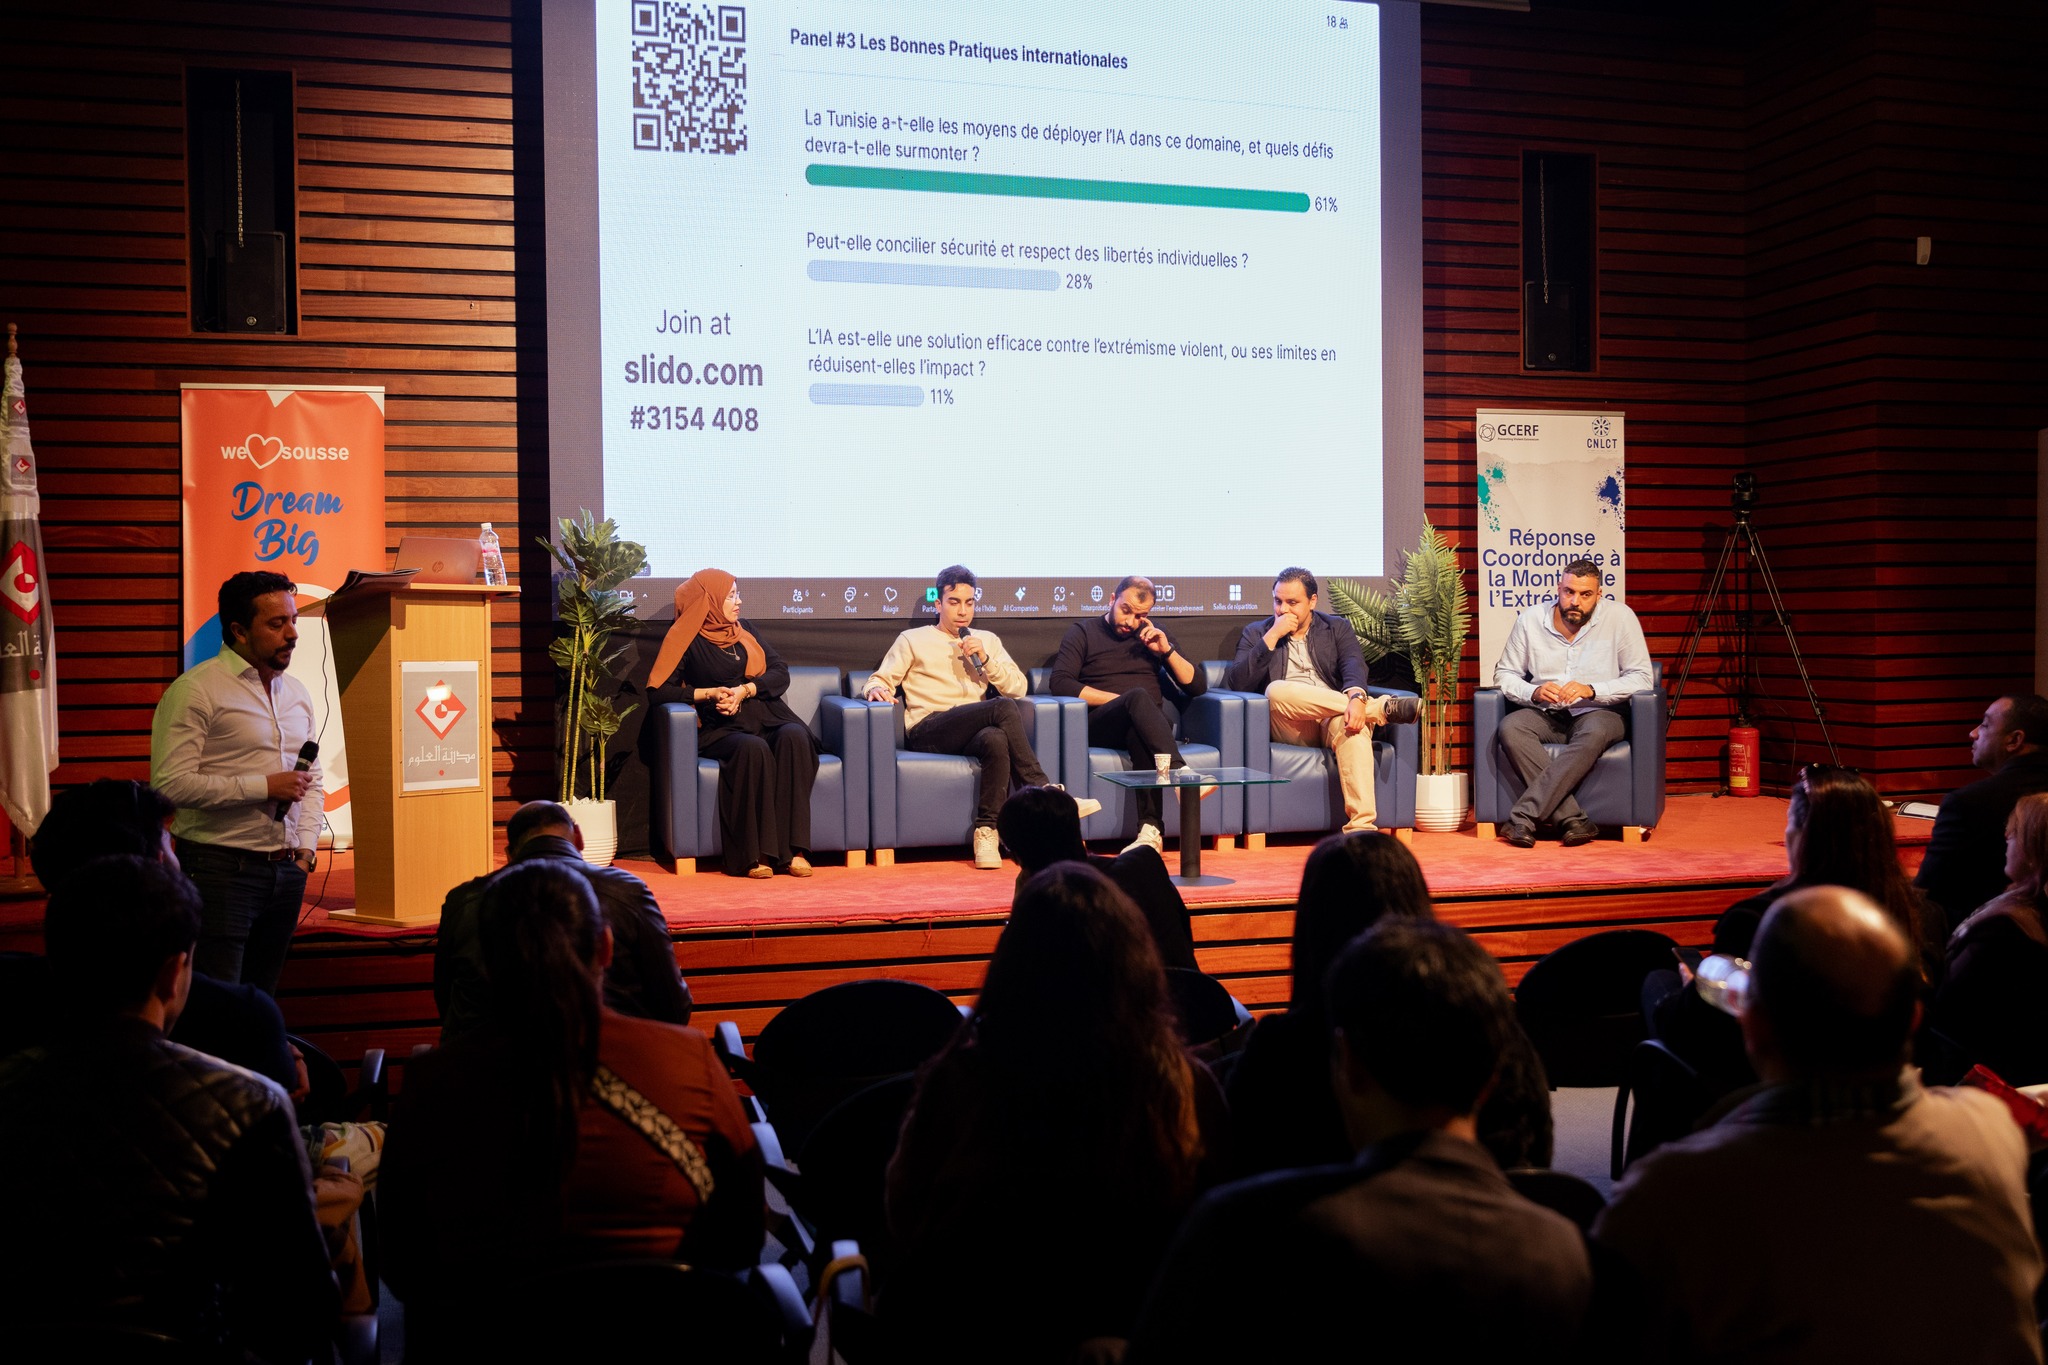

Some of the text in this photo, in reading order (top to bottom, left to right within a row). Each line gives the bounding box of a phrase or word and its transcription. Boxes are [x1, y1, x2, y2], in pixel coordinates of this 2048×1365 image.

[1326, 15, 1337, 28] 18
[790, 28, 1128, 69] Panel #3 Les Bonnes Pratiques internationales
[804, 109, 1333, 159] La Tunisie a-t-elle les moyens de déployer l'IA dans ce domaine, et quels défis
[804, 137, 979, 161] devra-t-elle surmonter ?
[1314, 196, 1338, 212] 61%
[806, 232, 1248, 268] Peut-elle concilier sécurité et respect des libertés individuelles ?
[1065, 274, 1092, 289] 28%
[655, 310, 731, 335] Join at
[808, 329, 1336, 361] L'IA est-elle une solution efficace contre l'extrémisme violent, ou ses limites en
[624, 353, 763, 386] slido.com
[808, 355, 985, 379] réduisent-elles l'impact ?
[930, 389, 954, 404] 11%
[629, 406, 758, 431] #3154 408
[1497, 424, 1539, 437] GCERF
[221, 446, 350, 460] we sousse
[1587, 438, 1618, 449] CNLCT
[231, 481, 344, 521] Dream
[254, 518, 320, 566] Big
[1509, 528, 1596, 550] Réponse
[1610, 549, 1621, 567] à
[1488, 569, 1506, 587] la
[782, 605, 814, 615] Participants
[844, 605, 857, 613] Chat
[407, 744, 441, 767] العلوم
